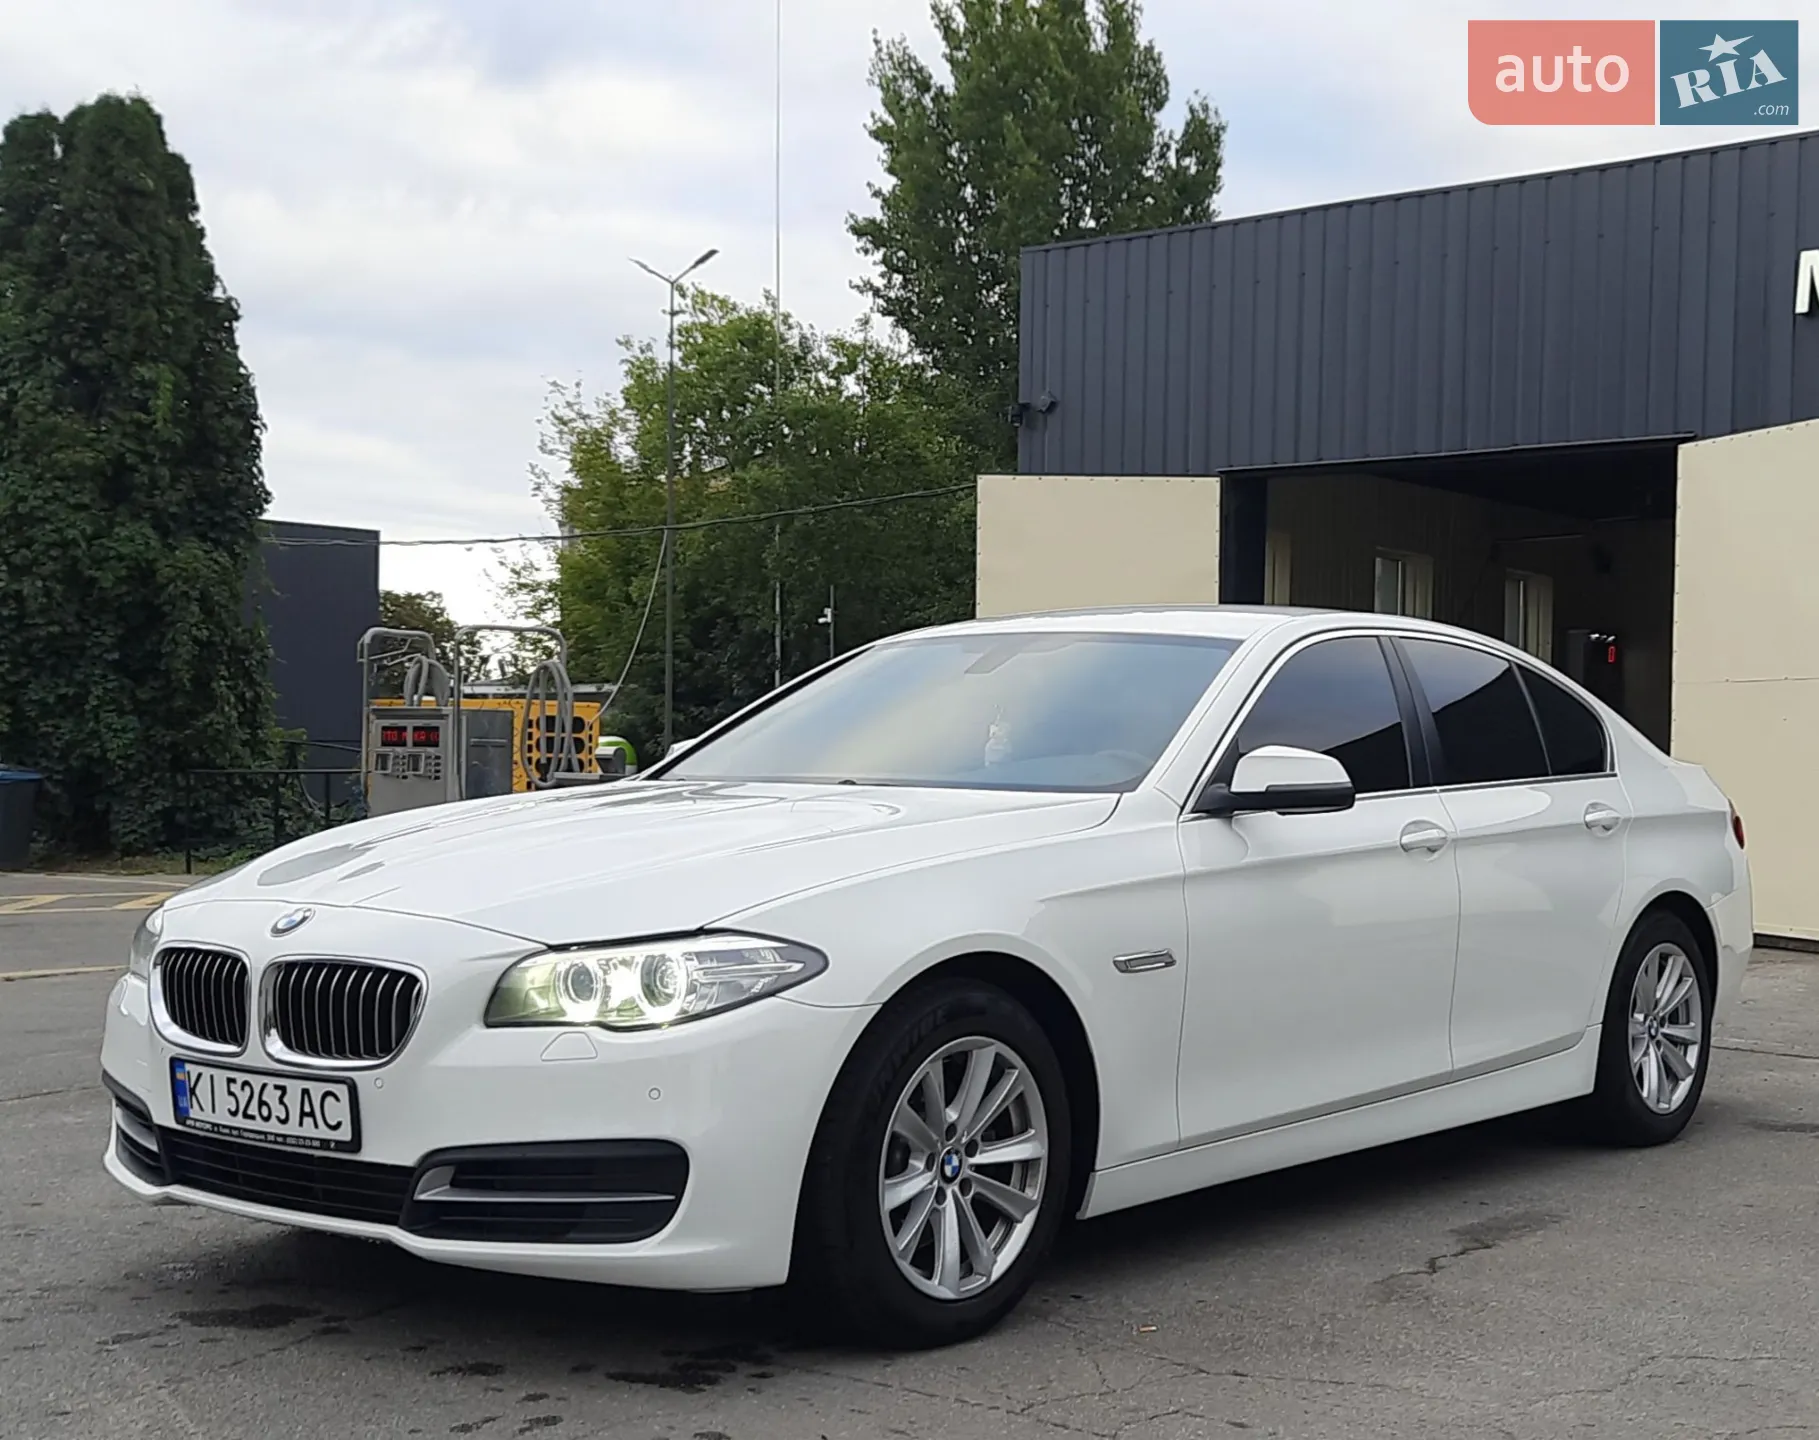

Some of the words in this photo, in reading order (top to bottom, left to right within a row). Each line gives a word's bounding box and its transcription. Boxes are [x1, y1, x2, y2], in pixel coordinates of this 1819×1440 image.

[187, 1070, 216, 1114] KI
[226, 1076, 290, 1125] 5263
[298, 1087, 343, 1131] AC
